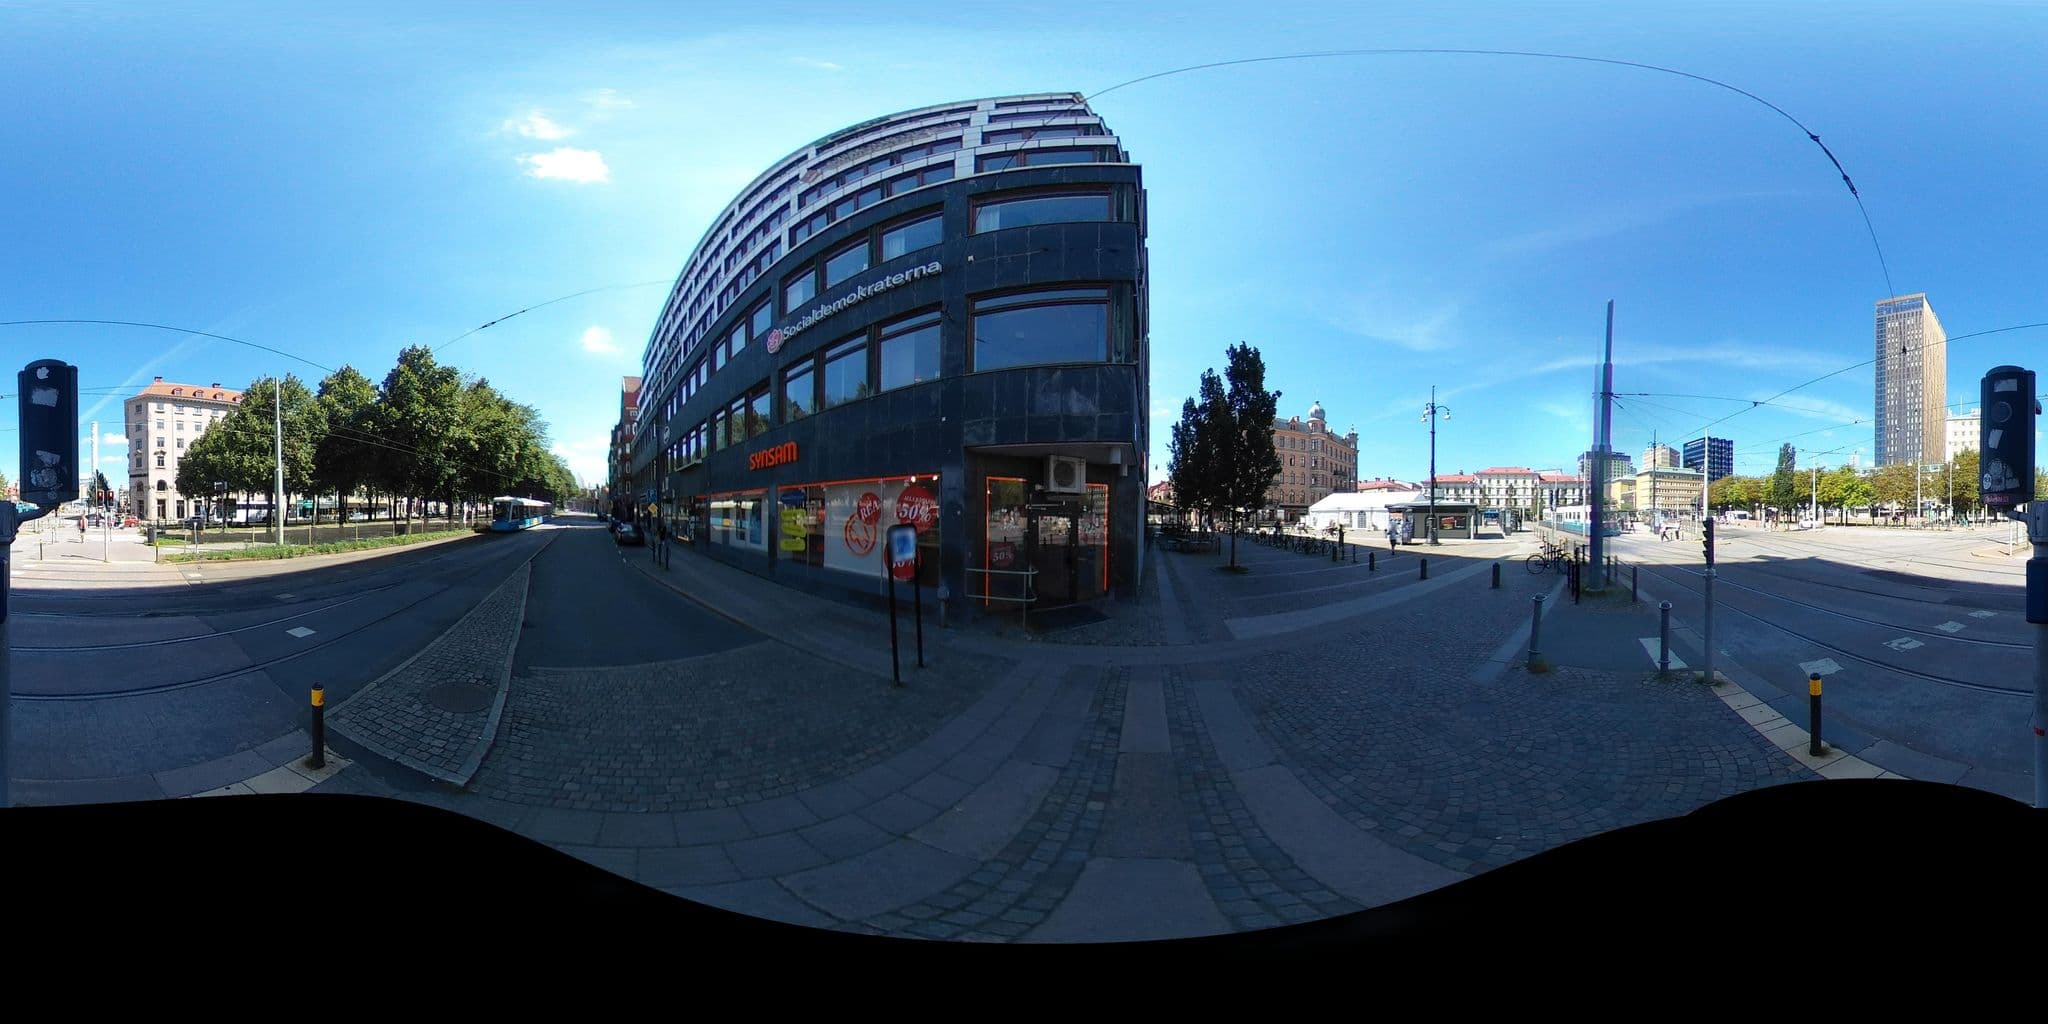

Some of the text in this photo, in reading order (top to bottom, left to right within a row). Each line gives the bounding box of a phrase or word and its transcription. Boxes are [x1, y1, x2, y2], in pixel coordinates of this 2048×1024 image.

[783, 260, 942, 340] Socialdemokraterna
[749, 441, 798, 470] SYNSAM
[899, 503, 932, 522] 50%
[992, 550, 1014, 562] 50%
